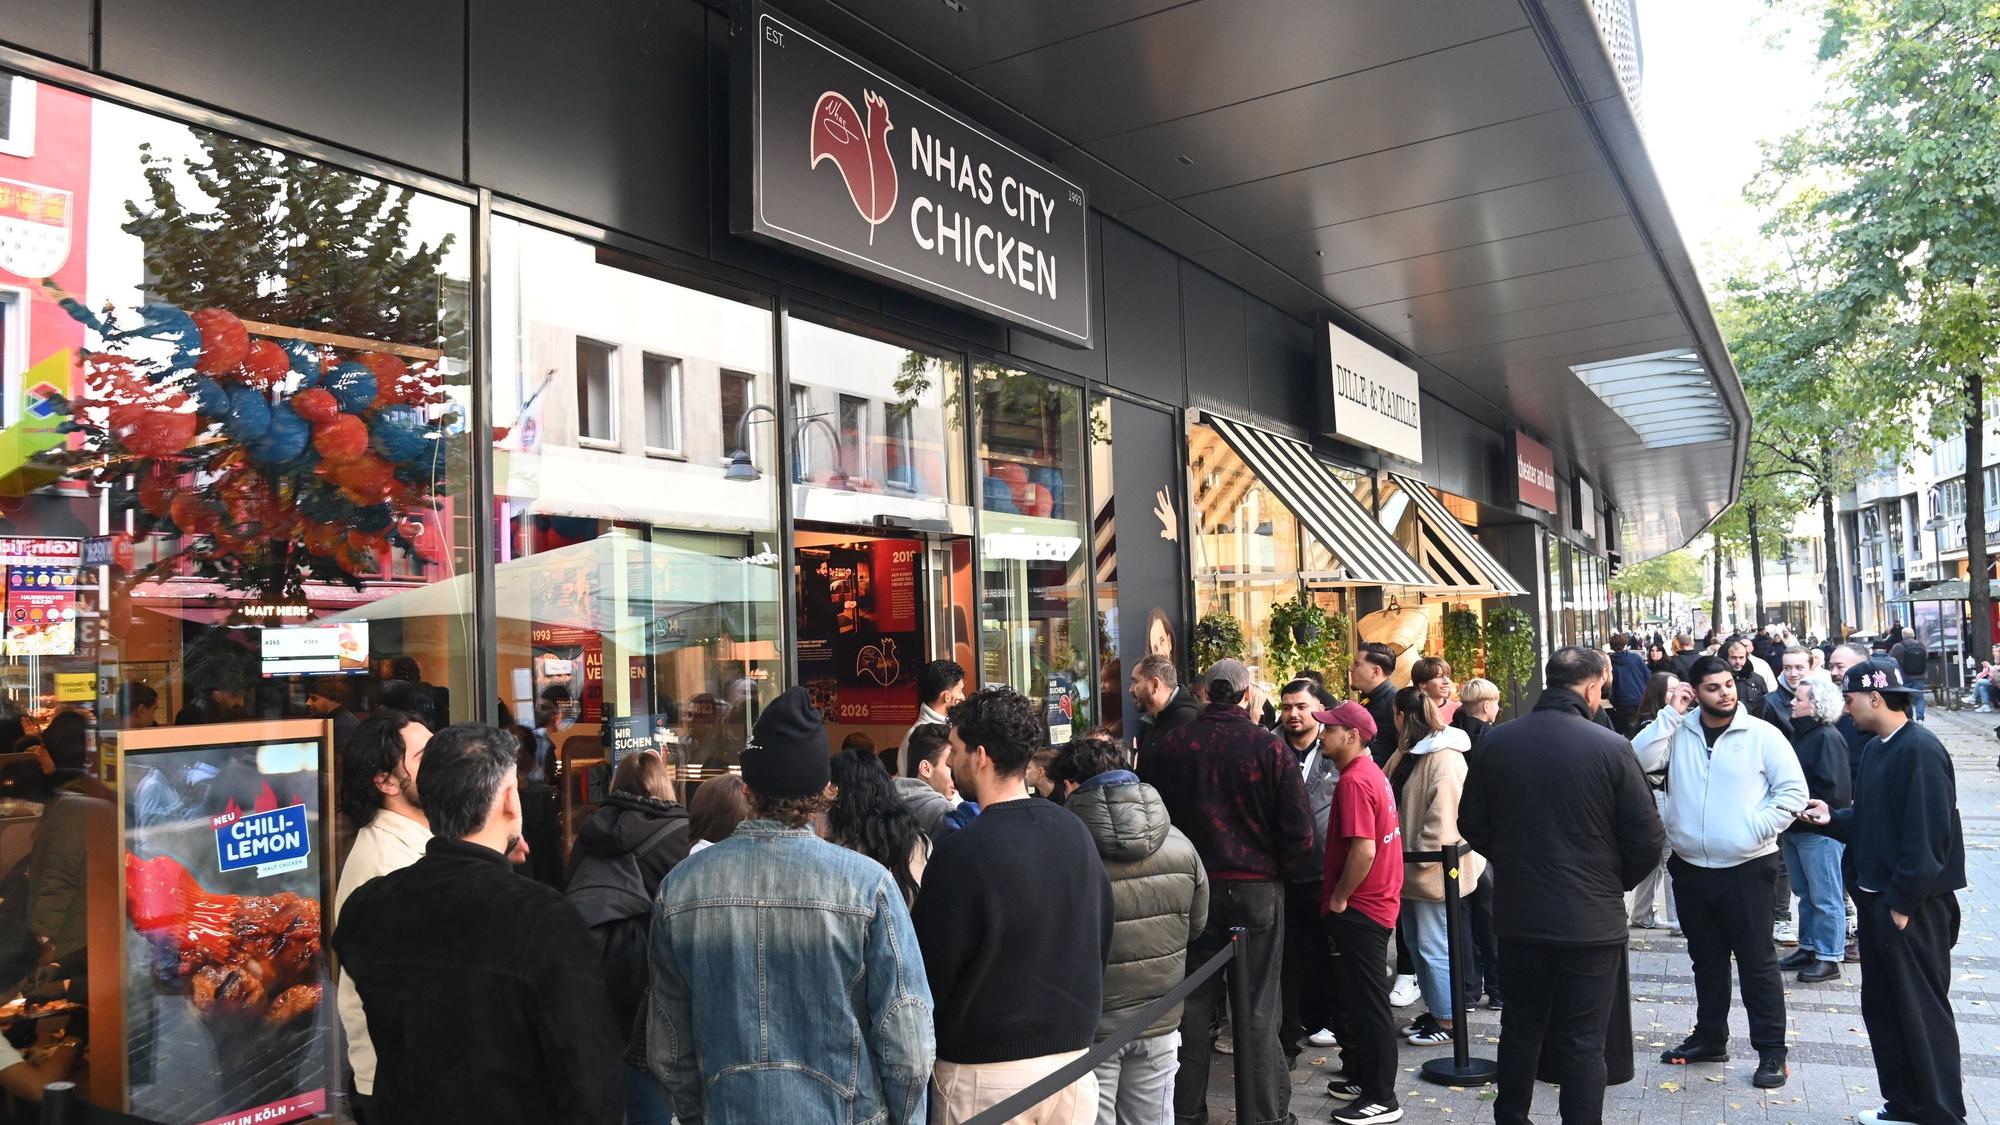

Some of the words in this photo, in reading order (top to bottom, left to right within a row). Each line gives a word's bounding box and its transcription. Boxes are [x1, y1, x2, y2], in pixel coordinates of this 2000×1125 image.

[766, 26, 785, 48] EST.
[911, 127, 993, 205] NHAS
[1001, 176, 1055, 234] CITY
[1068, 190, 1083, 207] 1993
[911, 196, 1056, 300] CHICKEN
[1336, 364, 1367, 407] DILLE
[1370, 380, 1378, 411] &
[1379, 385, 1418, 429] KAMILLE
[1517, 454, 1537, 484] theater
[1536, 468, 1544, 487] am
[1544, 466, 1555, 492] dom
[245, 606, 275, 616] WAIT
[277, 605, 308, 616] HERE
[533, 629, 551, 641] 1993
[841, 704, 869, 717] 2026
[615, 728, 631, 739] WIR
[615, 737, 652, 750] SUCHEN
[214, 812, 236, 826] NEU
[231, 814, 294, 840] CHILI-
[227, 831, 300, 861] LEMON
[263, 864, 278, 872] HALF
[279, 860, 303, 869] CHICKEN
[239, 1115, 252, 1125] IN
[255, 1105, 287, 1122] KÖLN
